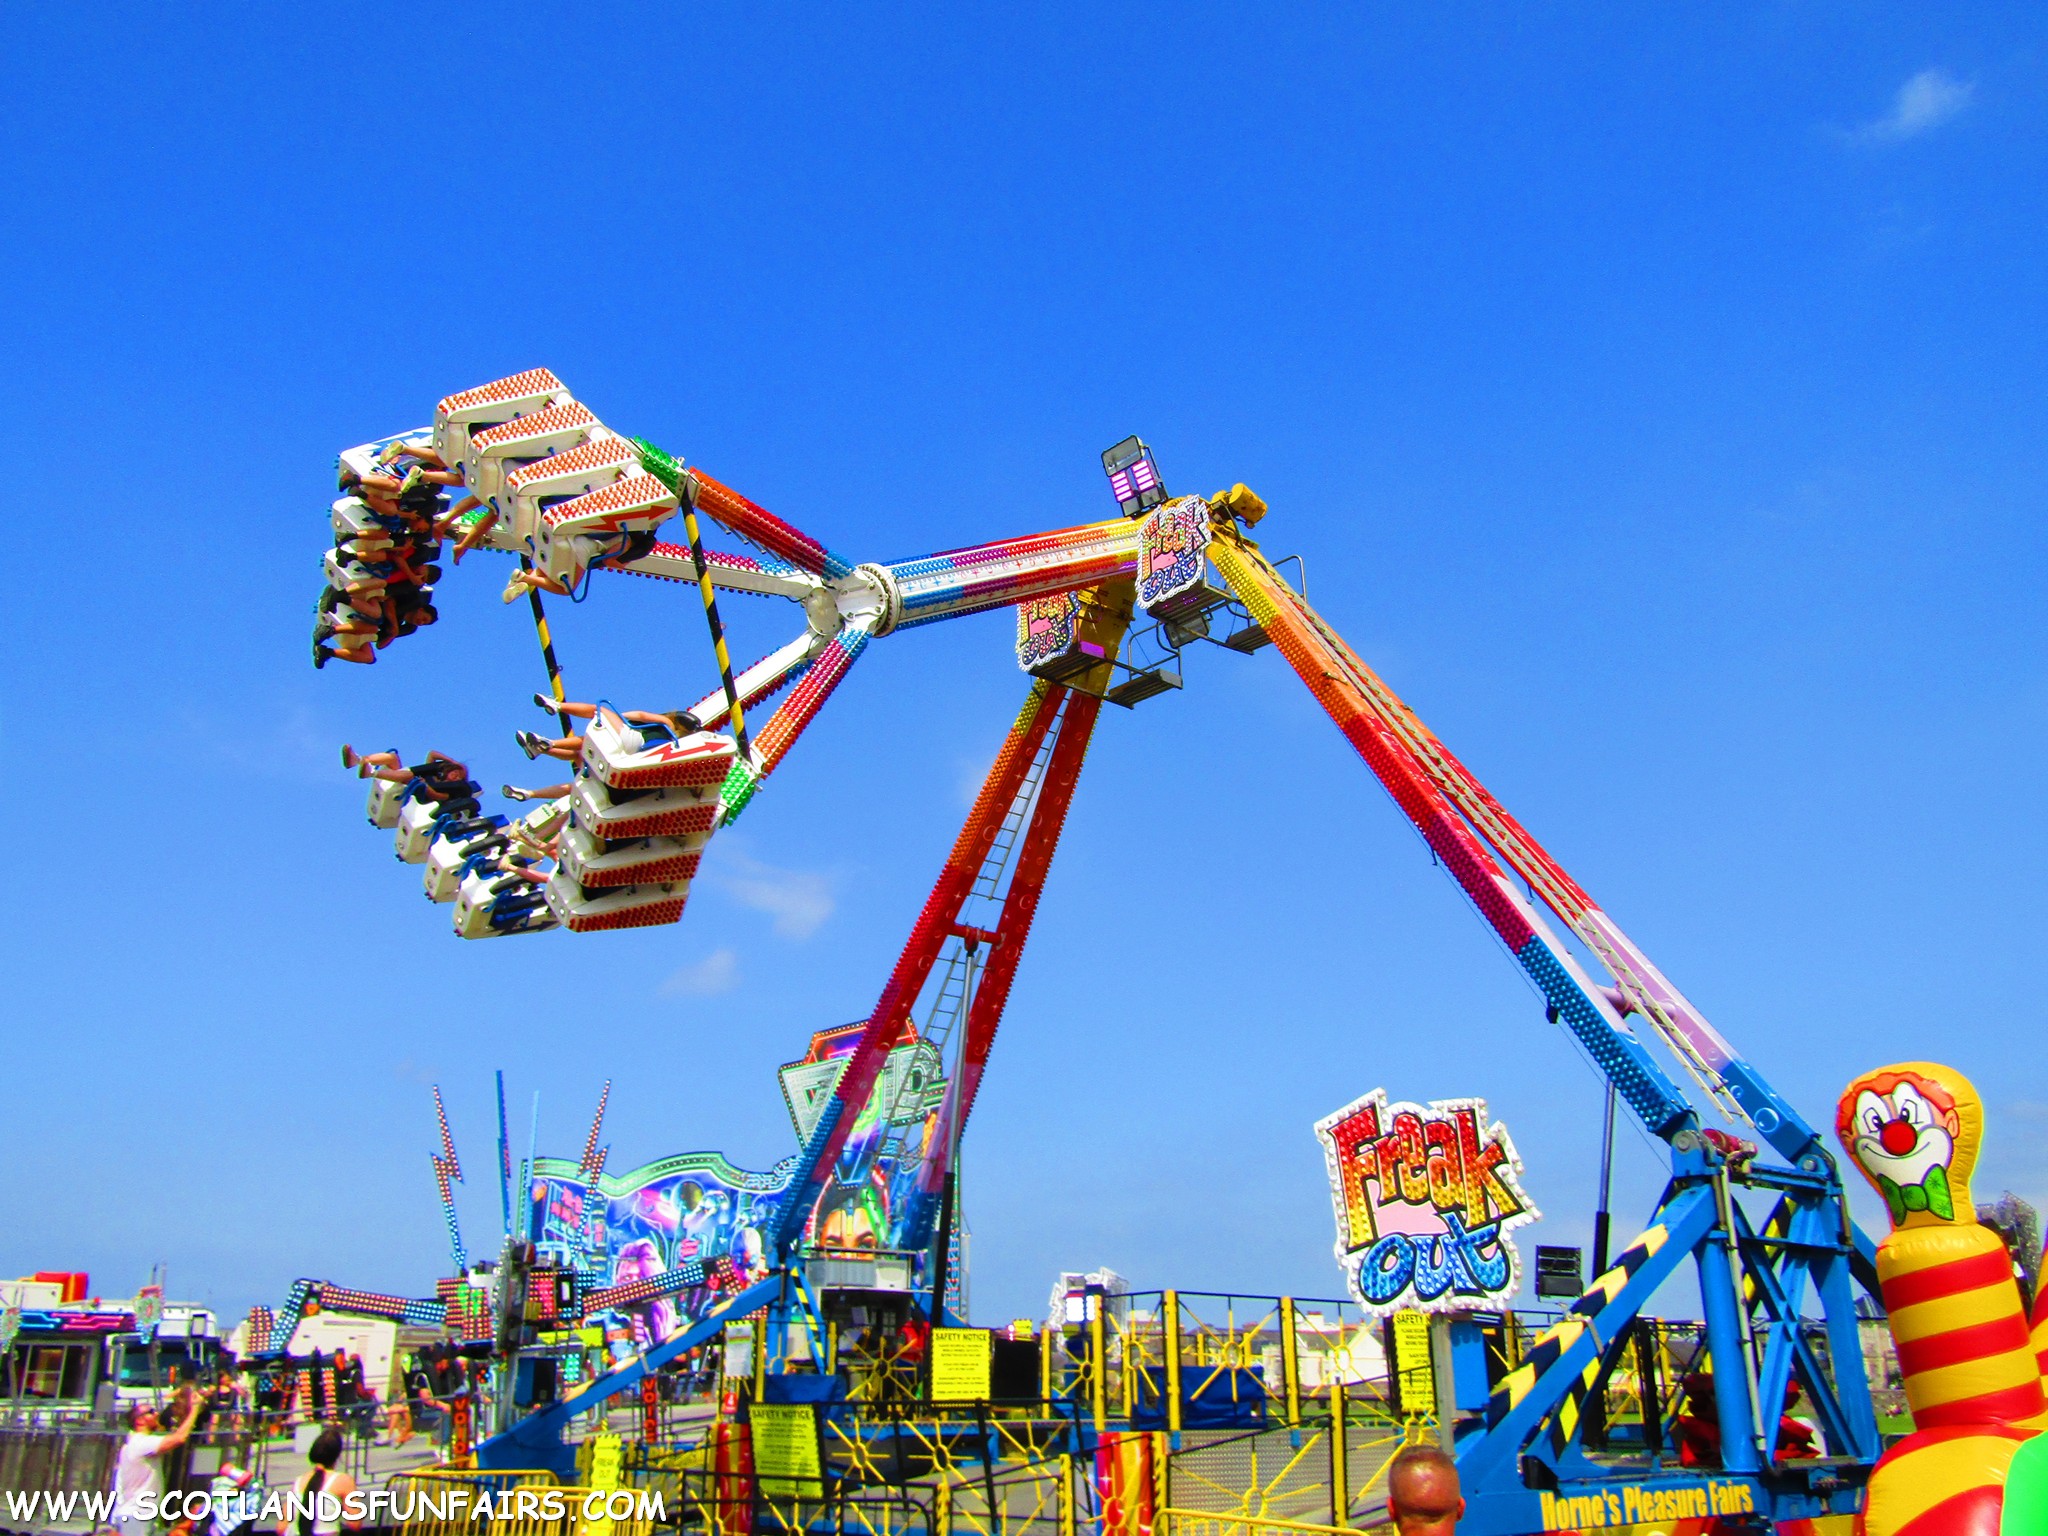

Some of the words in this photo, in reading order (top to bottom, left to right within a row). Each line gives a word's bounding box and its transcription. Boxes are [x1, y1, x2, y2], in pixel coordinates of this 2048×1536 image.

[1141, 503, 1207, 586] Freak
[1142, 551, 1198, 602] out
[1327, 1102, 1526, 1255] Freak
[1358, 1211, 1511, 1305] out
[935, 1332, 960, 1341] SAFETY
[963, 1333, 987, 1342] NOTICE
[1396, 1313, 1424, 1325] SAFETY
[1540, 1488, 1622, 1531] Horne's
[1622, 1485, 1708, 1523] Pleasure
[1708, 1480, 1754, 1515] Fairs
